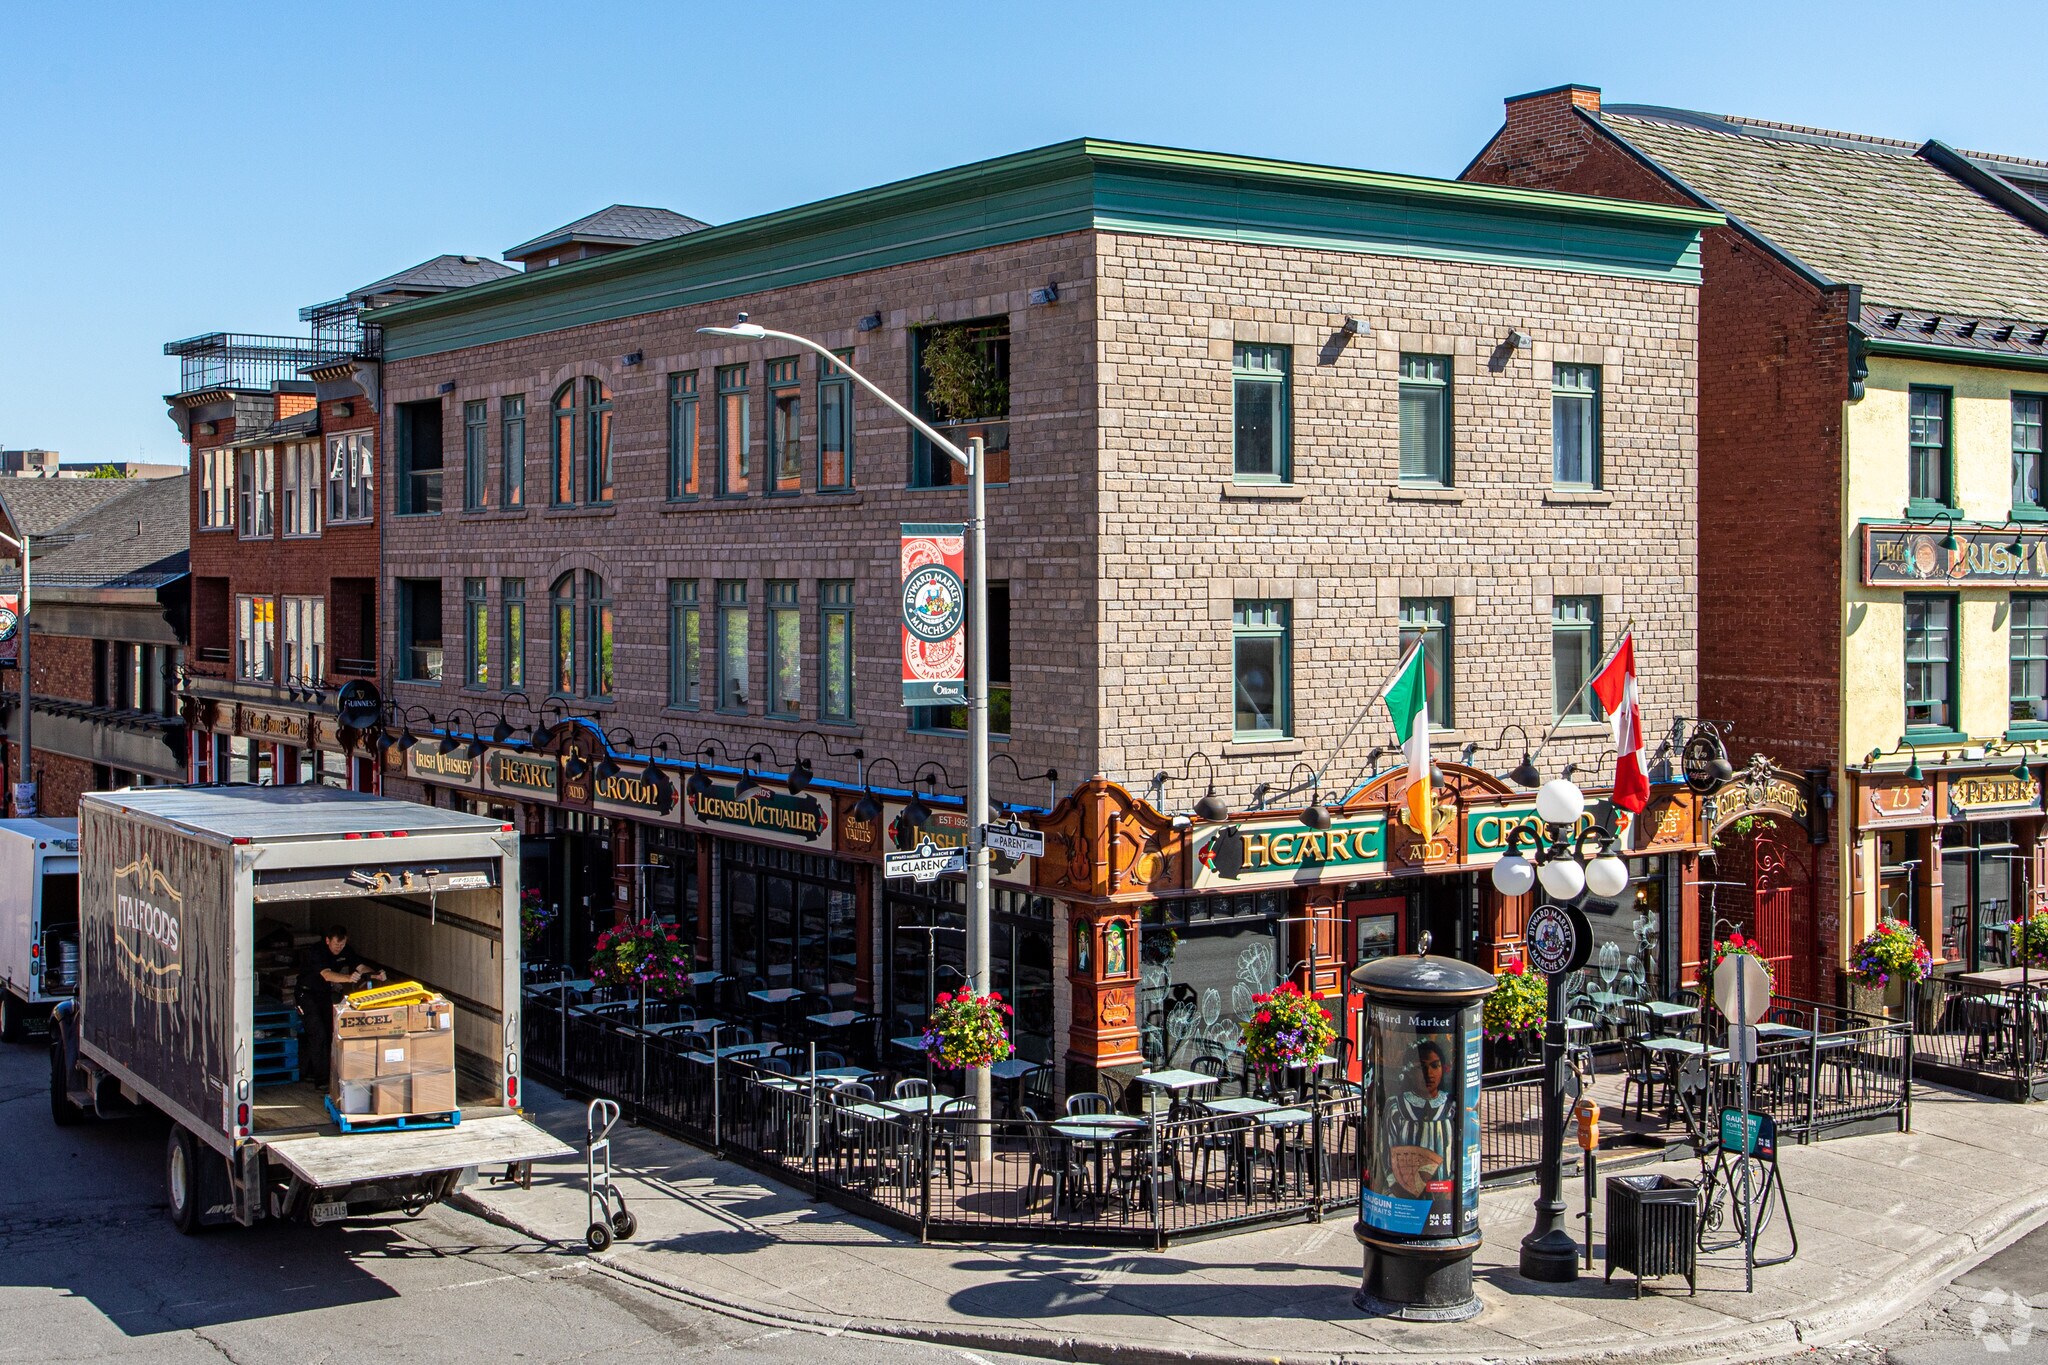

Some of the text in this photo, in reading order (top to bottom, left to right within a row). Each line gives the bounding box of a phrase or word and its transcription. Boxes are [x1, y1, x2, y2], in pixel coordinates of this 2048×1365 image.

[1876, 540, 1904, 561] THE
[906, 573, 932, 604] BYWARD
[933, 572, 960, 603] MARKET
[911, 616, 945, 635] MARCHÉ
[944, 616, 955, 628] BY
[954, 652, 962, 665] BY
[416, 750, 435, 770] IRISH
[436, 753, 473, 775] WHISKEY
[500, 757, 555, 789] HEART
[568, 785, 585, 799] AND
[595, 775, 659, 805] CROWN
[1890, 787, 1910, 808] 73
[1966, 779, 2029, 805] PETER
[698, 792, 817, 833] LICENSED VICTUALLER
[1654, 809, 1681, 823] IRISH
[845, 816, 872, 844] SPIRIT VAULTS
[1657, 820, 1677, 834] PUB
[999, 836, 1027, 850] PARENT
[1241, 826, 1380, 868] HEART
[1409, 843, 1445, 861] AND
[891, 864, 901, 872] RUE
[901, 858, 953, 873] CLARENCE
[118, 894, 179, 952] ITALFOODS
[1529, 909, 1571, 942] BYWARD MARKET
[1558, 954, 1567, 967] BY
[340, 1014, 393, 1028] EXCEL
[1408, 1016, 1450, 1027] Market
[1364, 1192, 1392, 1209] GAUGUIN
